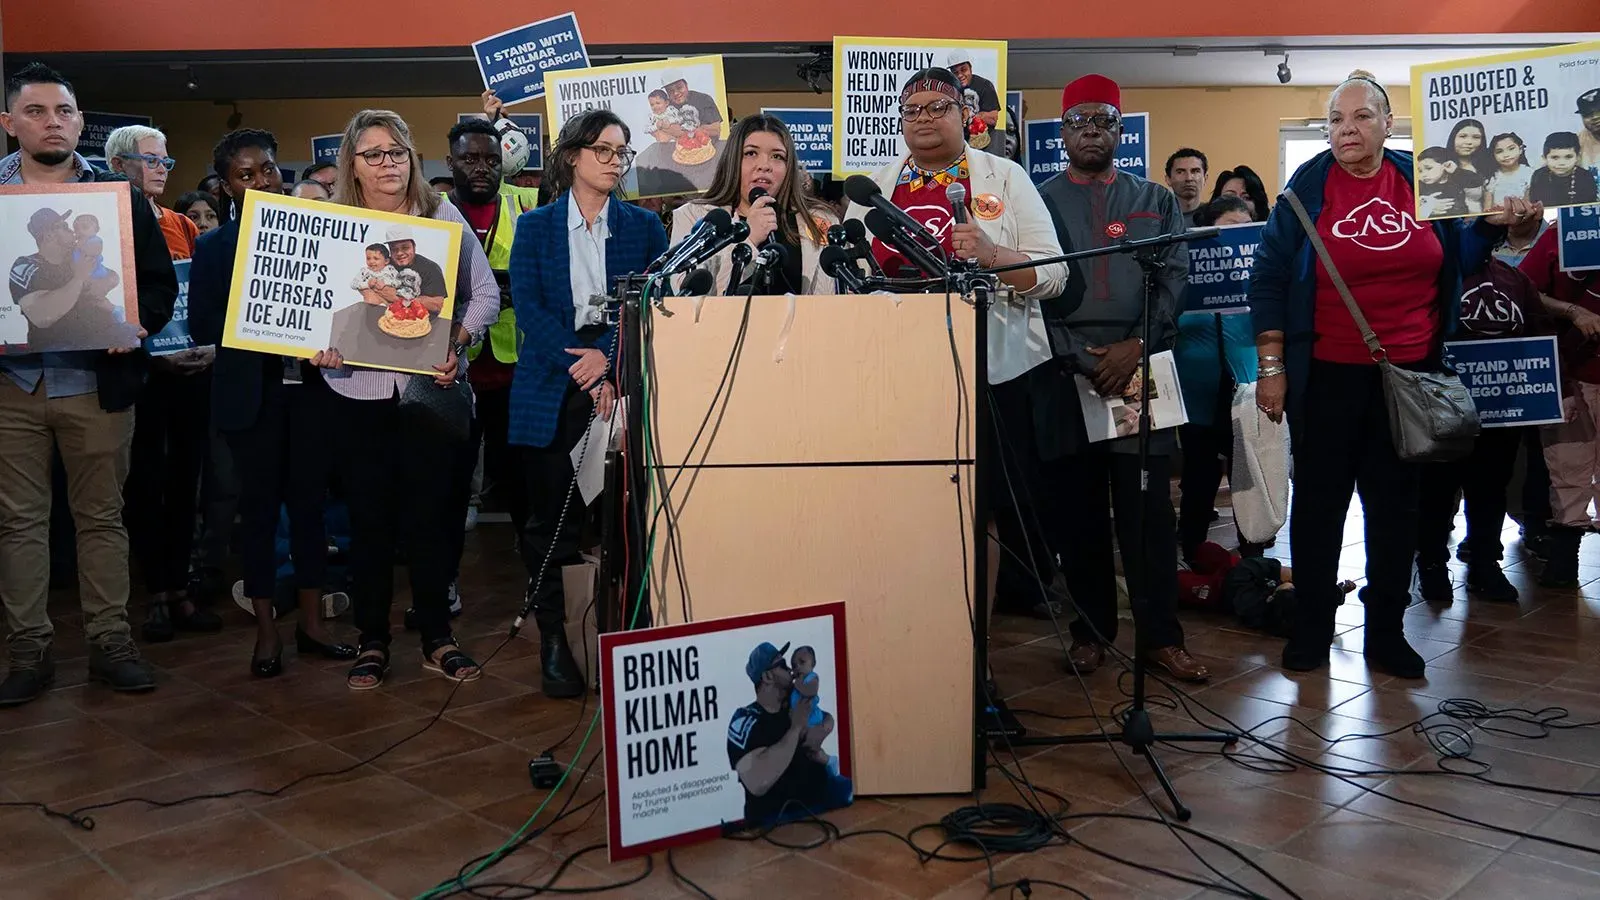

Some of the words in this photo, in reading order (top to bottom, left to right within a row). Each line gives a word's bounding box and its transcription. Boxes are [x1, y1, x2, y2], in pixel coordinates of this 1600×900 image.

[485, 56, 491, 64] I
[494, 42, 536, 62] STAND
[539, 30, 574, 48] WITH
[508, 47, 556, 68] KILMAR
[848, 51, 934, 70] WRONGFULLY
[1559, 60, 1576, 68] Paid
[1577, 58, 1588, 66] for
[1589, 58, 1599, 66] by
[489, 64, 536, 85] ABREGO
[538, 50, 583, 69] GARCIA
[560, 76, 646, 101] WRONGFULLY
[848, 73, 880, 92] HELD
[884, 74, 897, 92] IN
[1429, 68, 1517, 98] ABDUCTED
[1522, 66, 1535, 86] &
[1430, 88, 1548, 122] DISAPPEARED
[85, 124, 114, 132] TAND
[786, 124, 814, 132] TAND
[847, 116, 904, 136] OVERSEA
[810, 142, 832, 150] GAR
[847, 138, 867, 156] ICE
[871, 138, 898, 156] JAIL
[1036, 140, 1040, 150] I
[1121, 132, 1140, 144] TH
[846, 160, 860, 168] Bring
[1032, 162, 1070, 174] ABRE
[1113, 156, 1144, 168] RCIA
[261, 208, 369, 243] WRONGFULLY
[1332, 210, 1424, 238] CASA
[256, 231, 298, 256] HELD
[302, 238, 320, 260] IN
[1188, 246, 1234, 260] TAND
[254, 254, 328, 285] TRUMP’S
[1194, 257, 1254, 272] KILMAR
[249, 278, 334, 310] OVERSEAS
[1202, 294, 1248, 305] SMART
[246, 302, 272, 325] ICE
[276, 307, 312, 331] JAIL
[242, 326, 260, 336] Bring
[262, 330, 284, 338] Kilmar
[285, 332, 306, 342] home
[1455, 360, 1508, 374] STAND
[1513, 357, 1550, 371] WITH
[1472, 372, 1528, 386] KILMAR
[1506, 382, 1556, 396] GARCIA
[1480, 408, 1524, 420] SMART
[624, 646, 700, 692] BRING
[625, 685, 718, 736] KILMAR
[627, 731, 698, 780] HOME
[632, 785, 672, 800] Abducted
[672, 784, 679, 792] &
[680, 772, 730, 791] disappeared
[632, 802, 642, 810] by
[678, 784, 722, 801] deportation
[632, 806, 669, 819] machine
